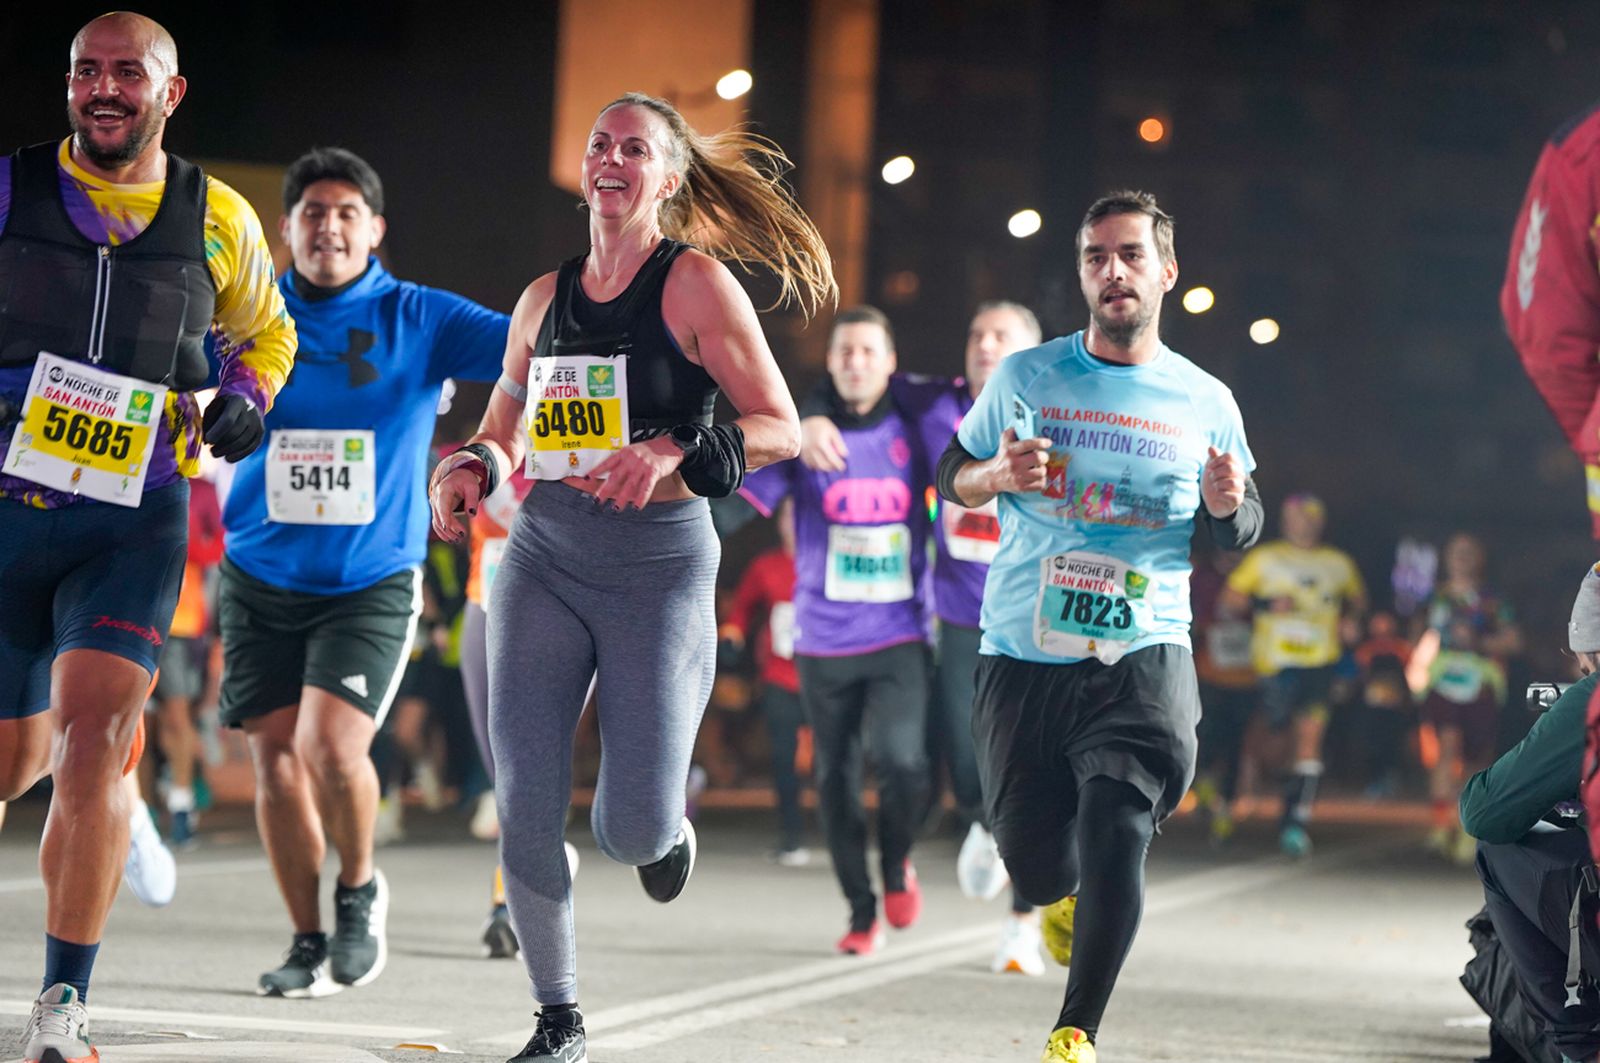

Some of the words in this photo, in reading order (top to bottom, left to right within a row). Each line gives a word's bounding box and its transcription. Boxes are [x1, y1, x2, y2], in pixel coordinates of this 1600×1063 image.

[63, 377, 103, 399] NOCHE
[104, 389, 119, 402] DE
[544, 382, 580, 398] ANTÓN
[564, 371, 577, 382] DE
[43, 386, 72, 405] SAN
[71, 396, 117, 418] ANTÓN
[43, 405, 134, 460] 5685
[535, 400, 605, 437] 5480
[1041, 406, 1183, 438] VILLARDOMPARDO
[1041, 425, 1072, 447] SAN
[1075, 430, 1133, 454] ANTÓN
[1136, 438, 1177, 462] 2026
[290, 465, 351, 491] 5414
[1053, 573, 1074, 586] SAN
[1076, 578, 1114, 593] ANTÓN
[1067, 563, 1101, 576] NOCHE
[1103, 569, 1116, 579] DE
[1060, 589, 1132, 630] 7823
